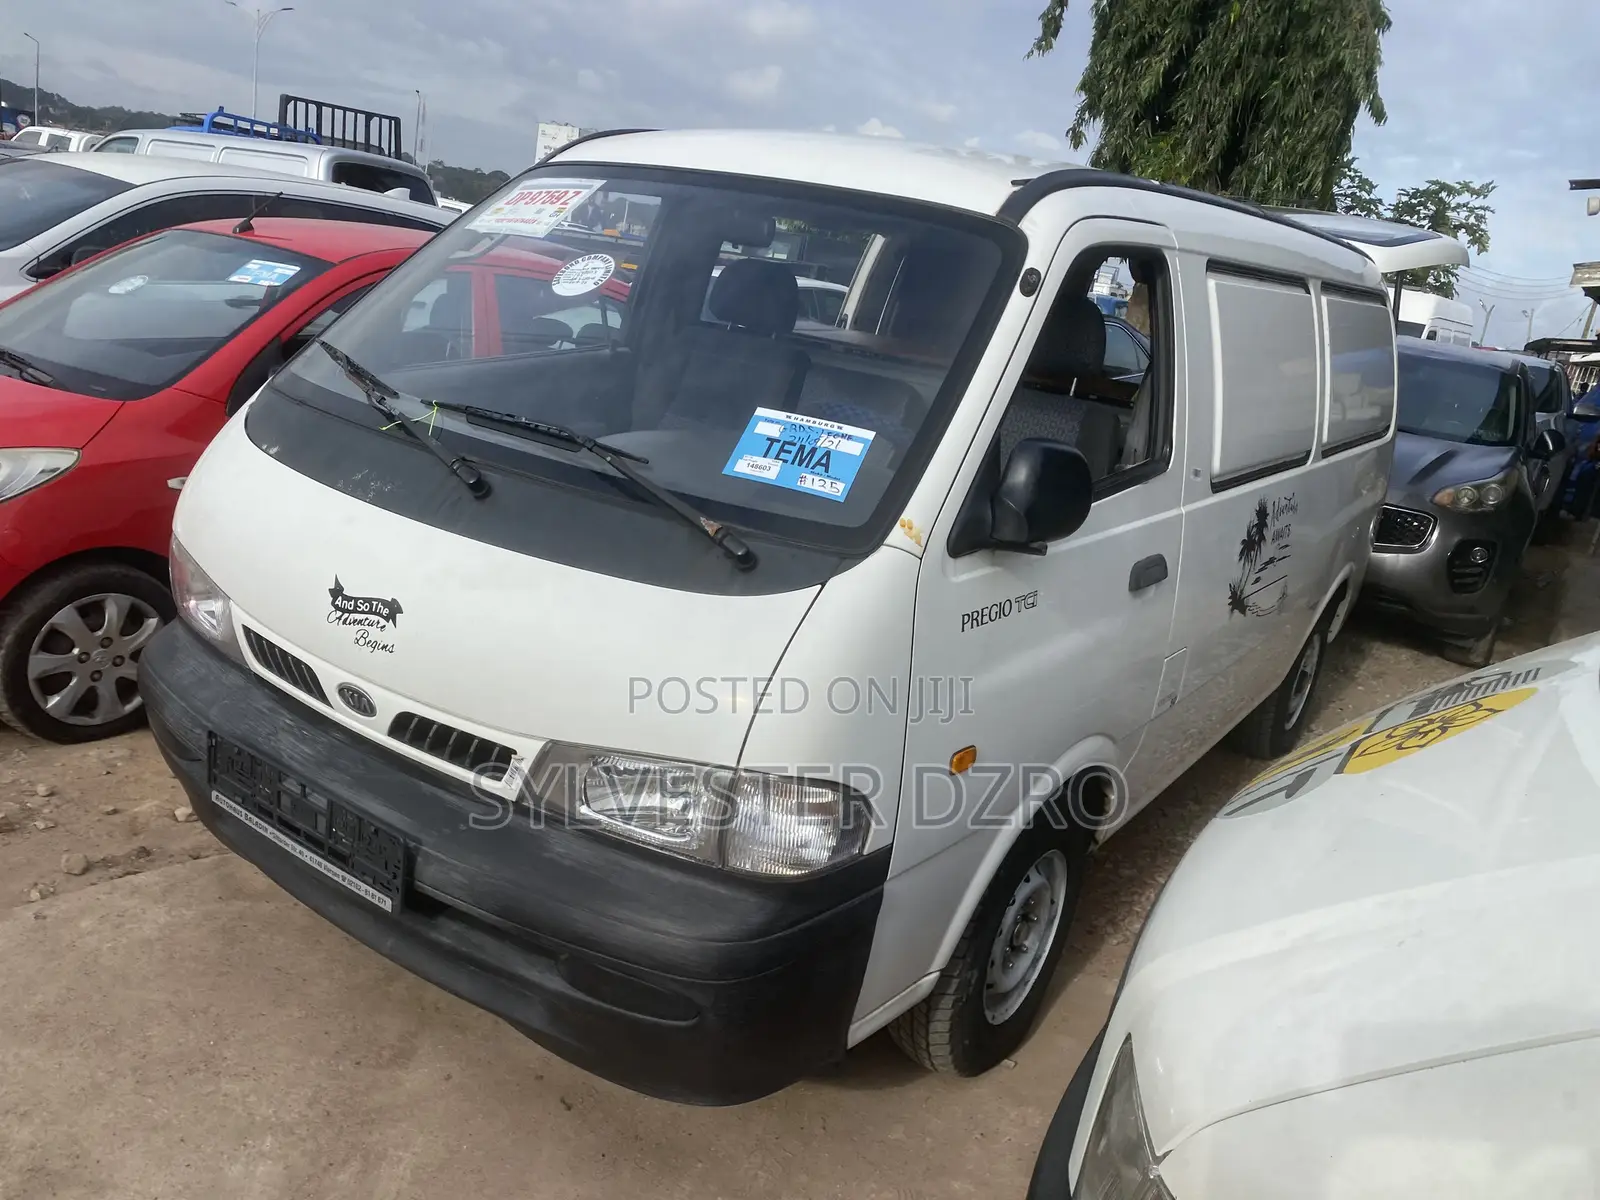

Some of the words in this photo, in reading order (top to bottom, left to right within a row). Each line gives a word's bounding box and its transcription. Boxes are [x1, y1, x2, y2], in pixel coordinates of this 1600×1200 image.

[793, 416, 835, 429] HAMBURG
[746, 462, 772, 472] 148603
[762, 437, 832, 474] TEMA
[334, 595, 355, 611] And
[356, 599, 370, 612] So
[371, 600, 390, 617] The
[961, 598, 1013, 633] PREGIO
[327, 609, 387, 633] Adventure
[354, 628, 396, 654] Begins
[342, 687, 372, 714] KIA
